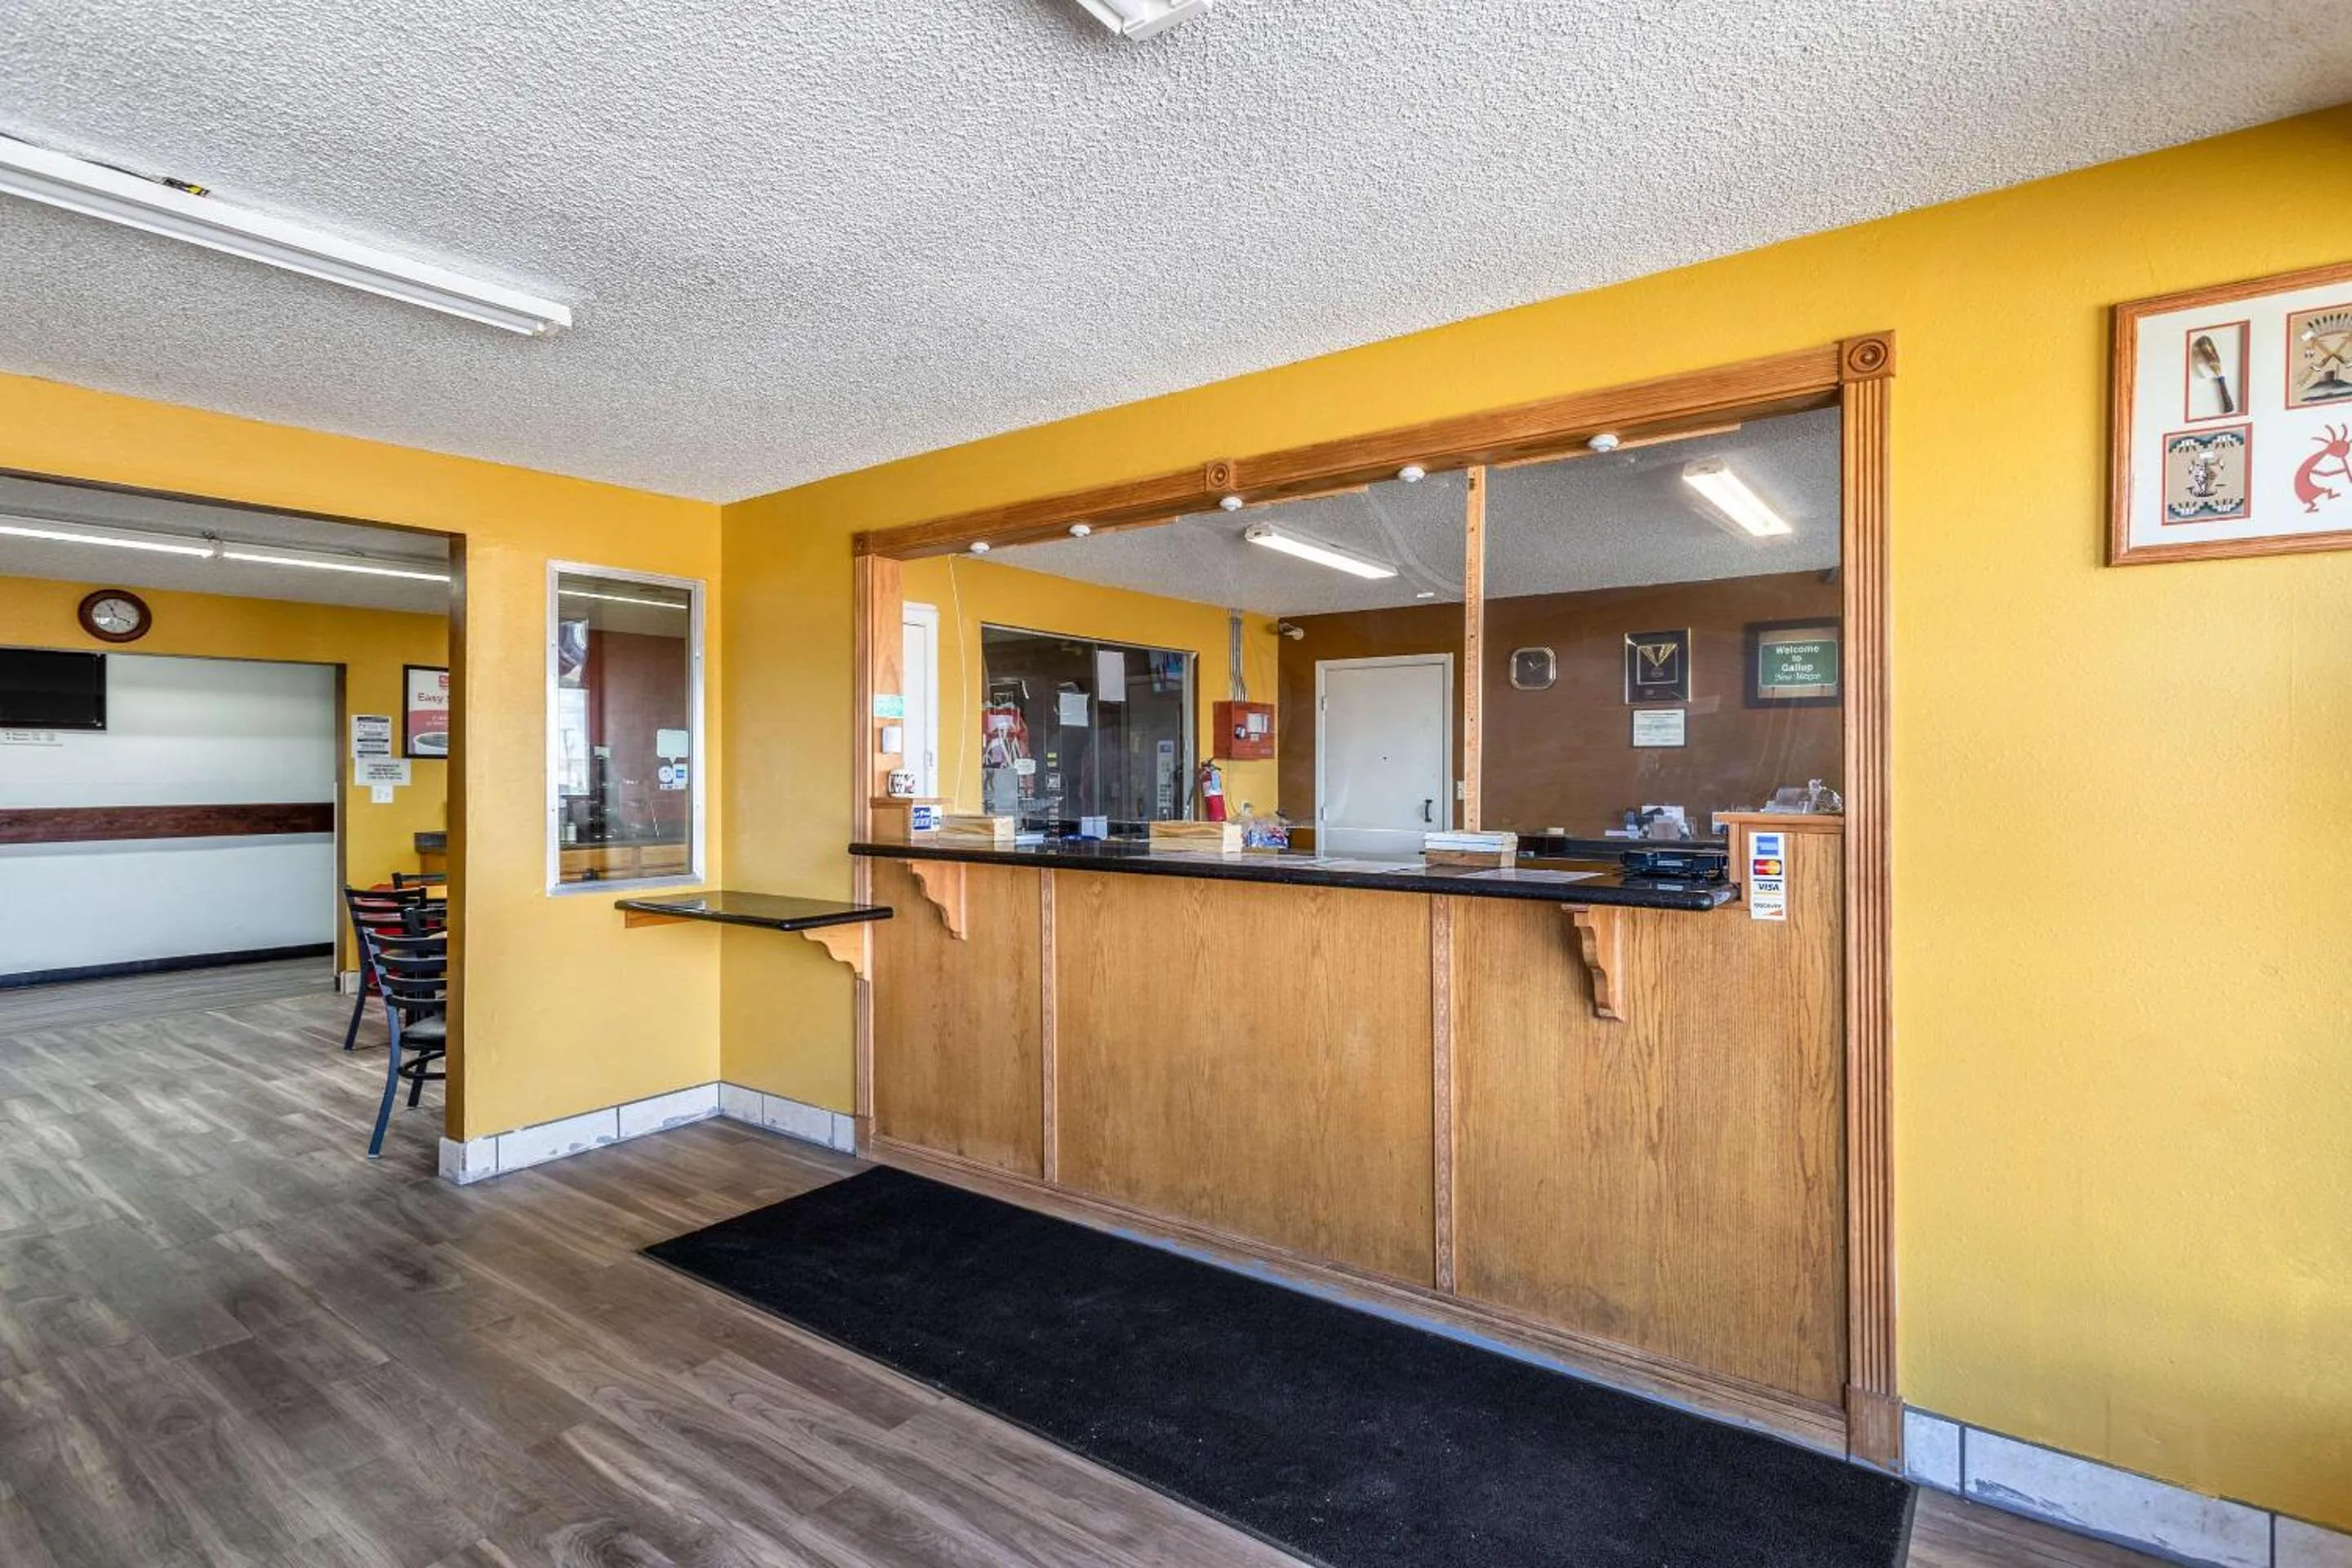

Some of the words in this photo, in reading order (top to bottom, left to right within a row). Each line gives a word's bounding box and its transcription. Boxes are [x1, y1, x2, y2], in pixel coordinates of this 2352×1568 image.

[1775, 645, 1820, 654] Welcome
[1781, 663, 1814, 672] Gallup
[417, 693, 443, 704] Easy
[1757, 883, 1780, 891] VISA
